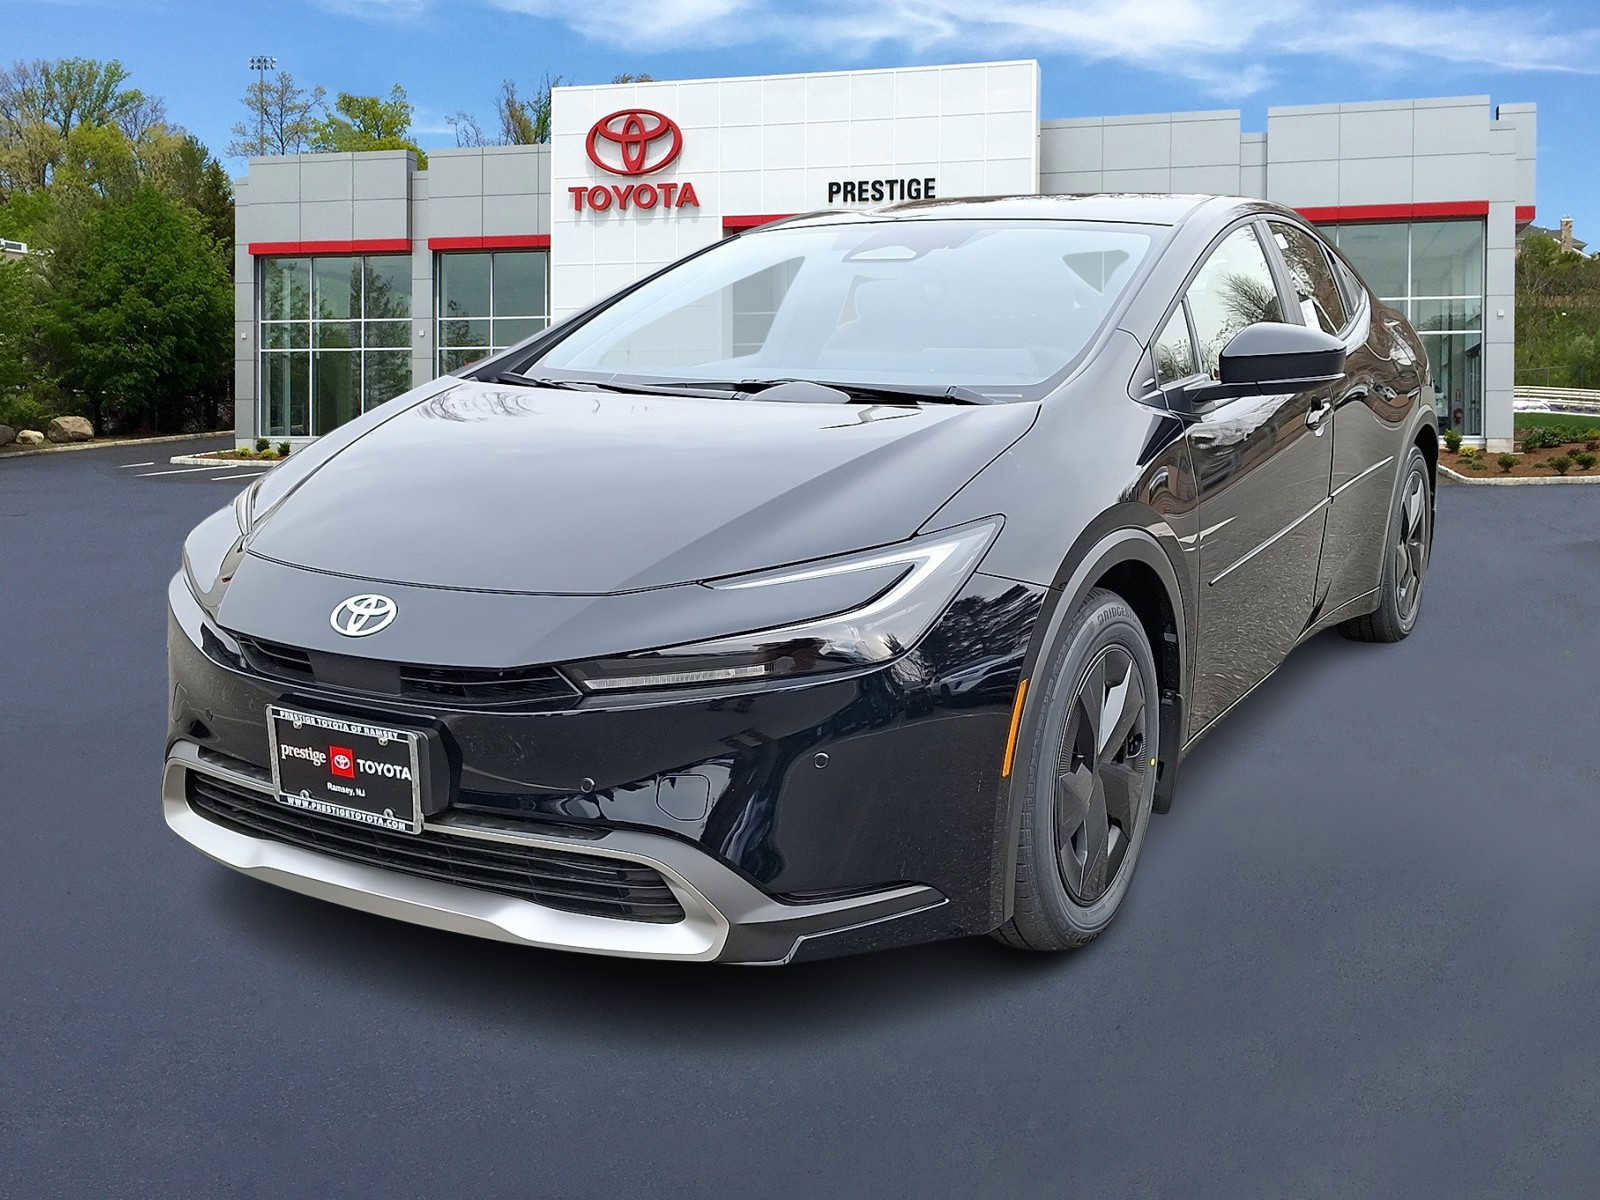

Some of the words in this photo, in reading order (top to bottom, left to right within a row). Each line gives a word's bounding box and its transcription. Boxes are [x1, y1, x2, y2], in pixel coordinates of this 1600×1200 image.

[568, 182, 700, 212] TOYOTA
[828, 178, 937, 203] PRESTIGE
[279, 710, 316, 725] PRESTIGE
[317, 719, 349, 731] TOYOTA
[350, 725, 362, 733] OF
[363, 727, 398, 740] RAMSEY
[280, 744, 327, 767] prestige
[356, 759, 412, 781] TOYOTA
[327, 782, 355, 797] Ramsey,
[355, 787, 366, 798] NJ
[287, 797, 406, 831] WWW.PRESTIGETOYOTA.COM
